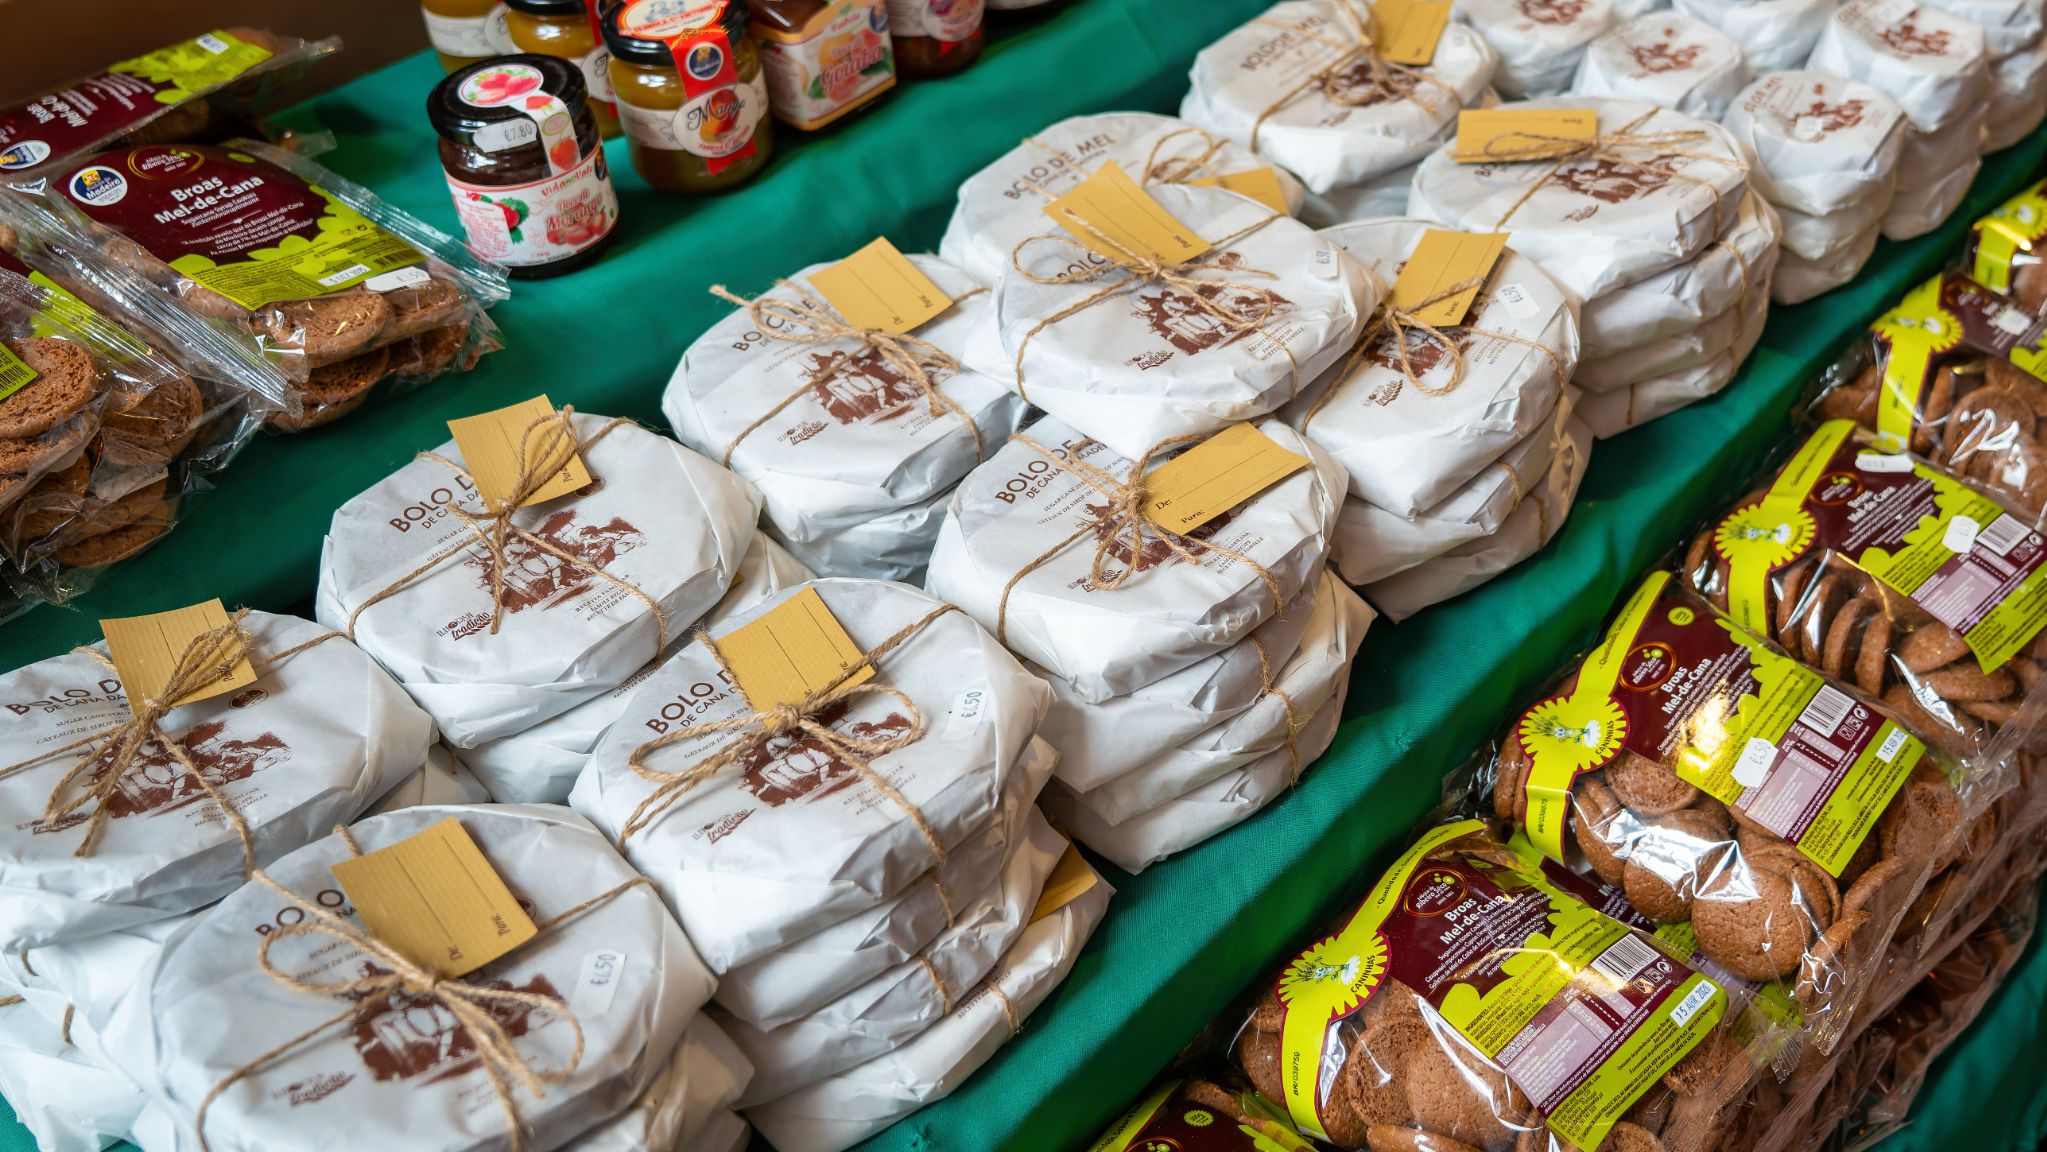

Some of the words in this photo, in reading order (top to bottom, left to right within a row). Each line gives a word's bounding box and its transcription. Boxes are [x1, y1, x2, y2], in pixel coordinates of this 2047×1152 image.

[505, 124, 533, 142] €7.80
[1003, 164, 1050, 200] BOLO
[1076, 133, 1118, 155] MEL
[84, 178, 121, 201] Madeira
[153, 175, 265, 225] Mel-de-Cana
[170, 174, 224, 203] Broas
[995, 460, 1050, 505] BOLO
[1025, 486, 1041, 500] DE
[1036, 466, 1065, 490] CANA
[389, 487, 454, 533] BOLO
[1043, 498, 1062, 513] SUGAR
[1062, 503, 1072, 514] DE
[1154, 497, 1173, 512] De:
[1181, 506, 1207, 525] Para:
[421, 517, 438, 530] DE
[450, 611, 492, 640] tradição
[1660, 665, 1689, 694] Broas
[1660, 657, 1713, 716] Mel-de-Cana
[5, 688, 92, 716] BOLO
[43, 703, 64, 714] DE
[64, 694, 107, 708] CANA
[646, 682, 715, 735] BOLO
[680, 713, 698, 728] DE
[695, 692, 730, 715] CANA
[55, 716, 84, 728] SUGAR
[77, 726, 89, 735] DE
[1595, 719, 1616, 756] CANINHAS
[1414, 890, 1436, 909] Ribeiro
[1444, 894, 1477, 923] Broas
[1438, 891, 1504, 945] Mel-de-Cana
[1436, 940, 1461, 960] Sugarcane
[1457, 930, 1473, 944] Honey
[1350, 953, 1377, 994] CANINHAS
[1674, 1006, 1689, 1022] 15
